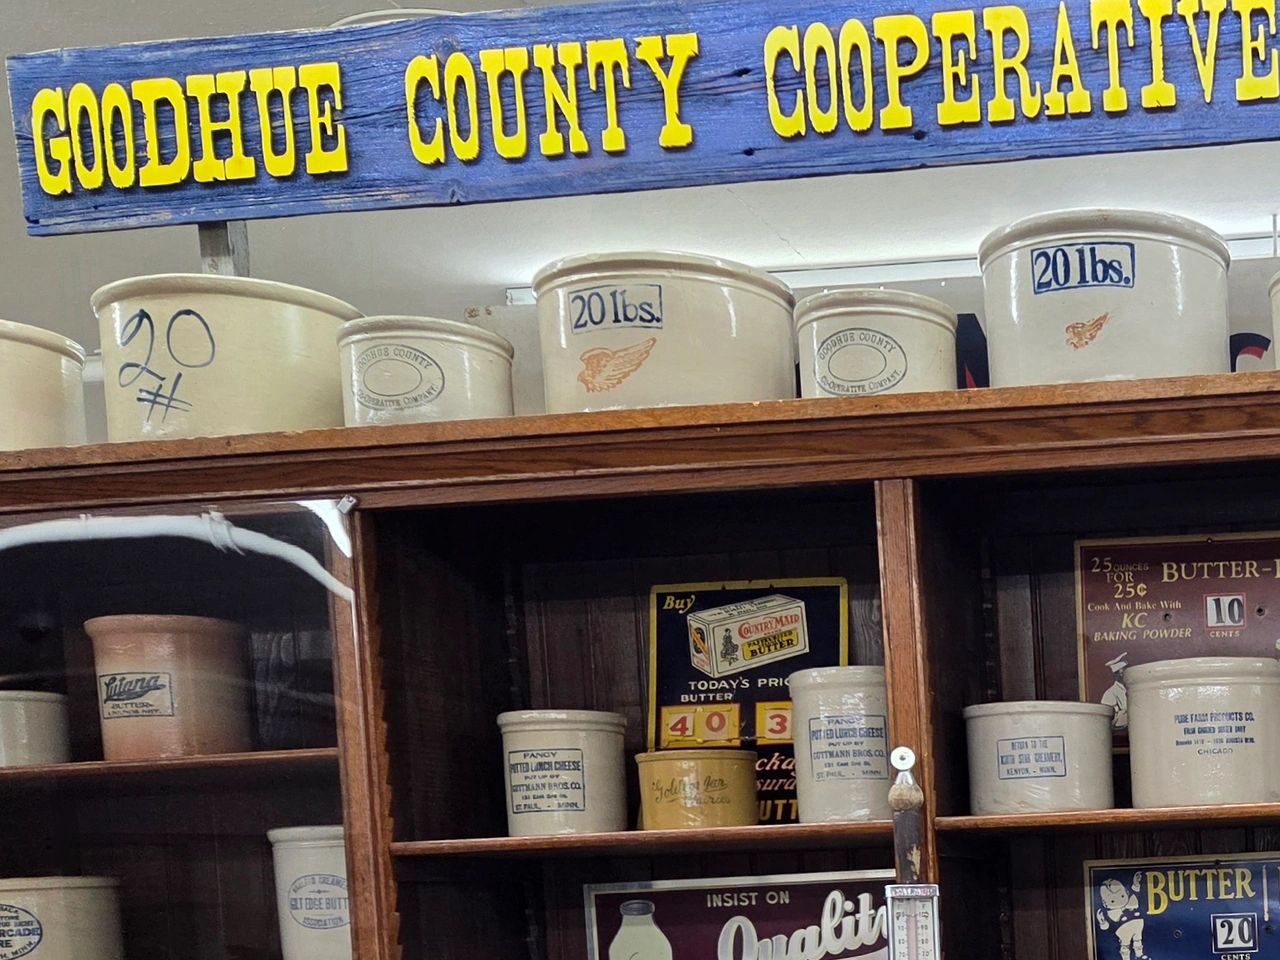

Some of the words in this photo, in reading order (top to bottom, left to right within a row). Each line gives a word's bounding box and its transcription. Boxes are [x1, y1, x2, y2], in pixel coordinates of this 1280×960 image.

[31, 61, 349, 195] GOODHUE
[405, 32, 701, 165] COUNTY
[765, 0, 1280, 137] COOPERATIVE
[1034, 248, 1071, 289] 20
[1076, 245, 1131, 286] lbs.
[573, 292, 607, 329] 20
[611, 288, 662, 325] lbs.
[118, 308, 216, 388] 20
[818, 332, 855, 361] GOODHUE
[858, 331, 897, 354] COUNTY
[392, 346, 432, 369] COUNTY
[1091, 557, 1112, 573] 25
[1113, 562, 1149, 572] OUNCES
[1106, 571, 1134, 583] FOR
[1113, 583, 1147, 599] 25¢
[663, 595, 695, 614] Buy
[1088, 602, 1111, 612] Cook
[1115, 602, 1131, 611] And
[1135, 601, 1157, 610] Bake
[1160, 600, 1182, 610] With
[1213, 597, 1244, 625] 10
[1121, 613, 1147, 629] KC
[1094, 631, 1137, 643] BAKING
[1143, 628, 1192, 640] POWDER
[750, 638, 795, 658] BUTTER
[688, 677, 750, 691] TODAY'S
[757, 677, 790, 688] PRIC
[680, 692, 734, 703] BUTTER
[768, 713, 788, 735] 3
[859, 727, 884, 738] CHEESE
[523, 751, 557, 760] FANCY
[554, 760, 582, 772] CHEESE
[707, 894, 757, 908] INSIST
[766, 891, 790, 905] ON
[1146, 867, 1256, 915] BUTTER
[1219, 917, 1253, 945] 20
